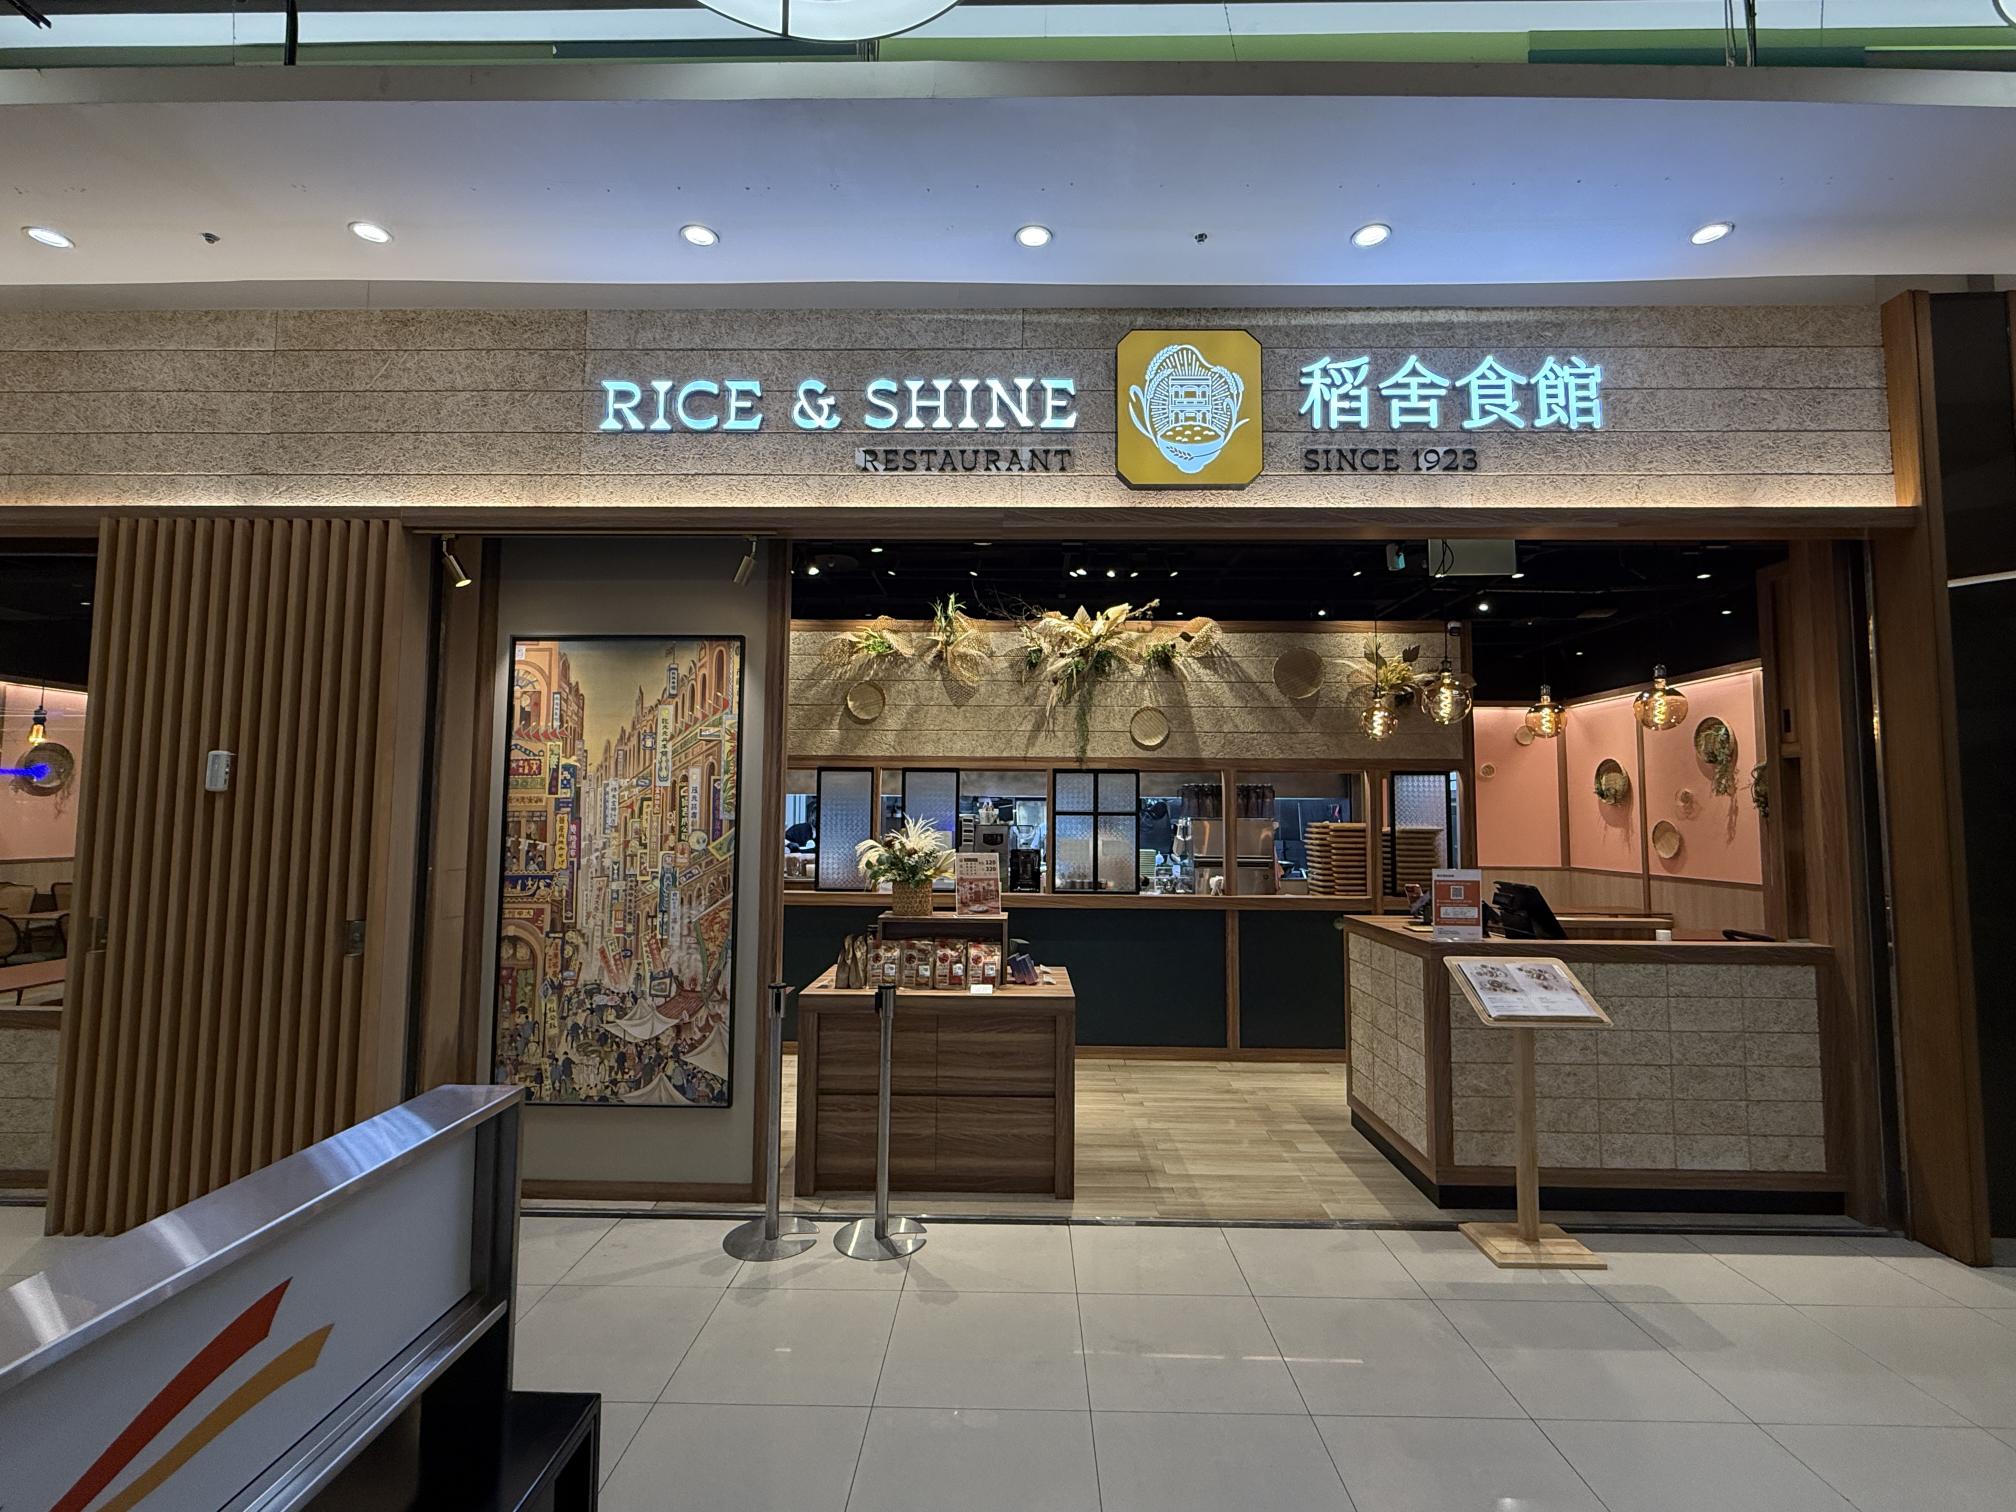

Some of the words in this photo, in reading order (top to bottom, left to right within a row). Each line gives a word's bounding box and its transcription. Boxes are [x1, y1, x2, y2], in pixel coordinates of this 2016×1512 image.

[599, 379, 763, 432] RICE
[792, 378, 842, 432] &
[864, 377, 1078, 431] SHINE
[1299, 354, 1603, 430] 稻舍食館
[861, 448, 1072, 472] RESTAURANT
[1303, 448, 1400, 472] SINCE
[1413, 448, 1478, 472] 1923
